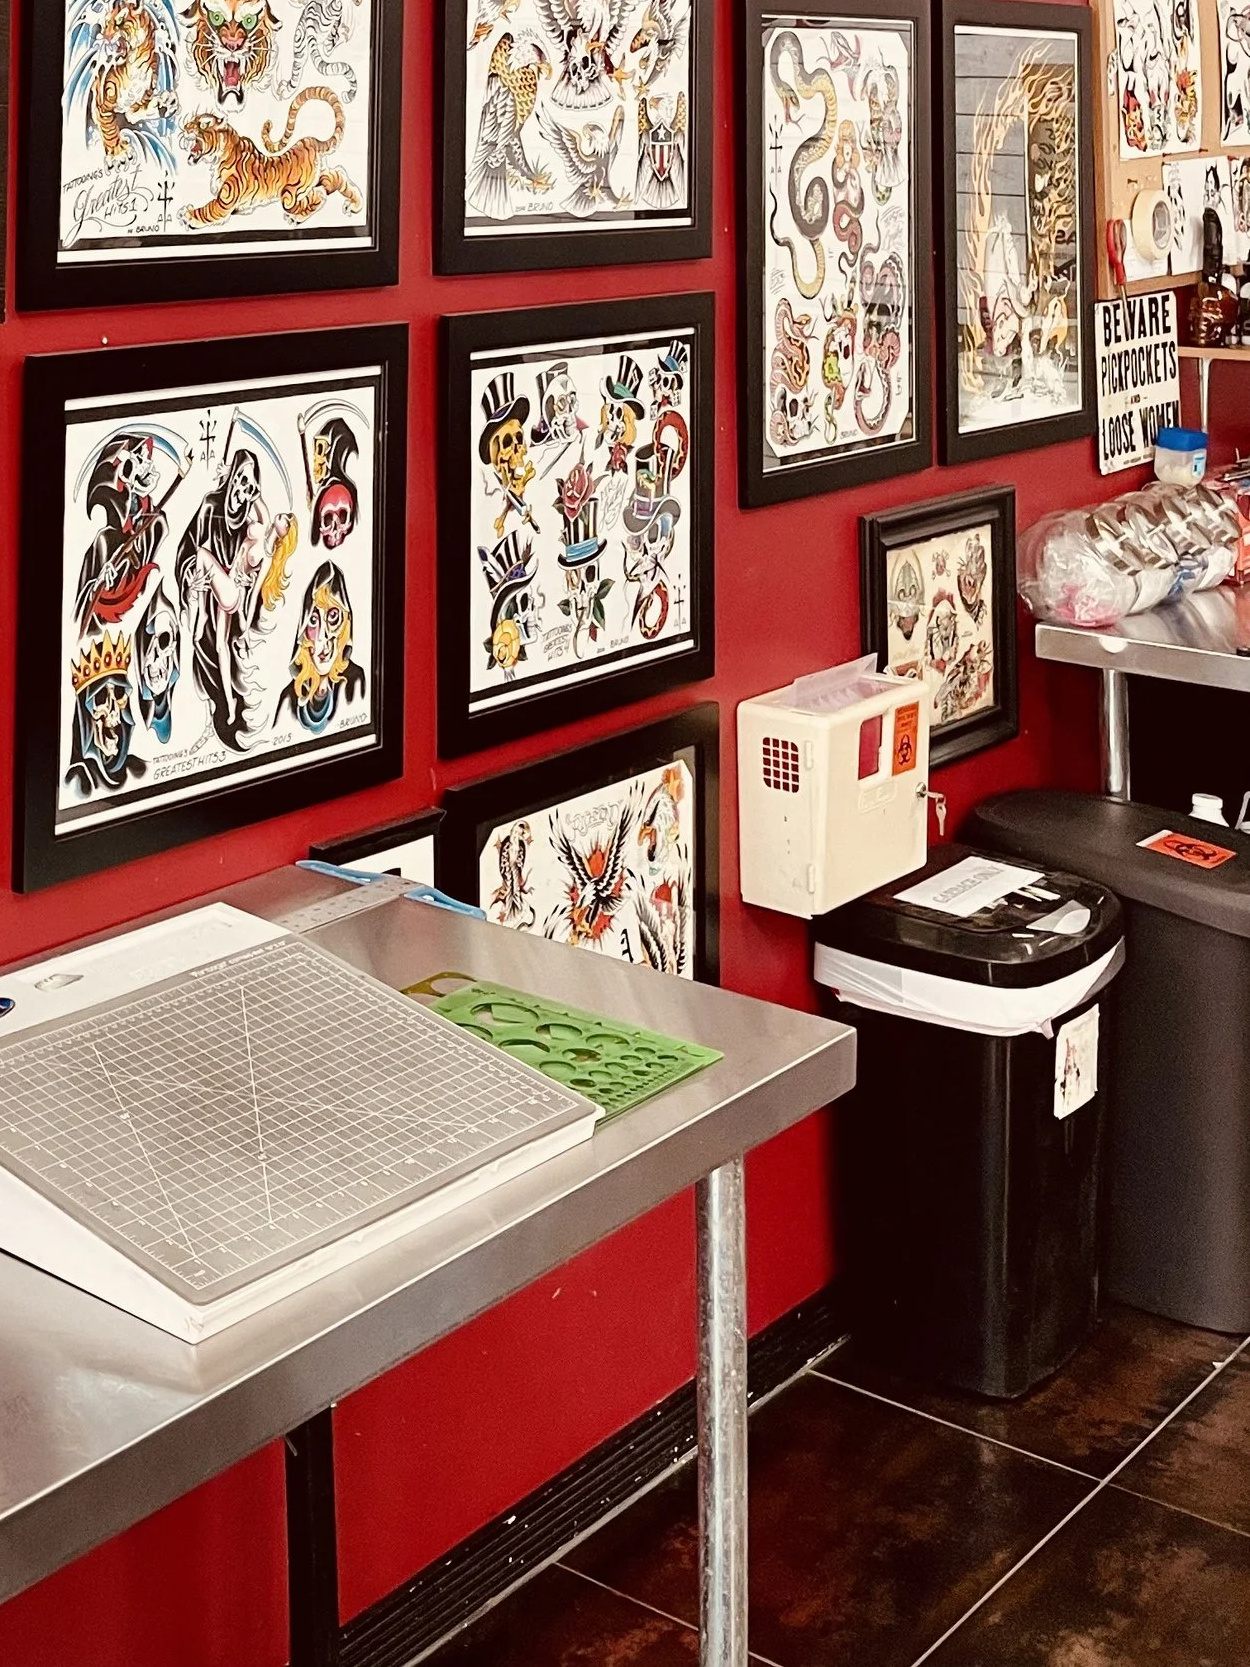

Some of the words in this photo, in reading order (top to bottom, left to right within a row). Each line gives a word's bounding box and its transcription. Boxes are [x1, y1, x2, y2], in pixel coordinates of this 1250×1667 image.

[1103, 294, 1171, 347] BEWARE
[1101, 340, 1177, 397] PICKPOCKETS
[1102, 410, 1136, 461] LOOSE
[339, 713, 368, 729] BRUNO
